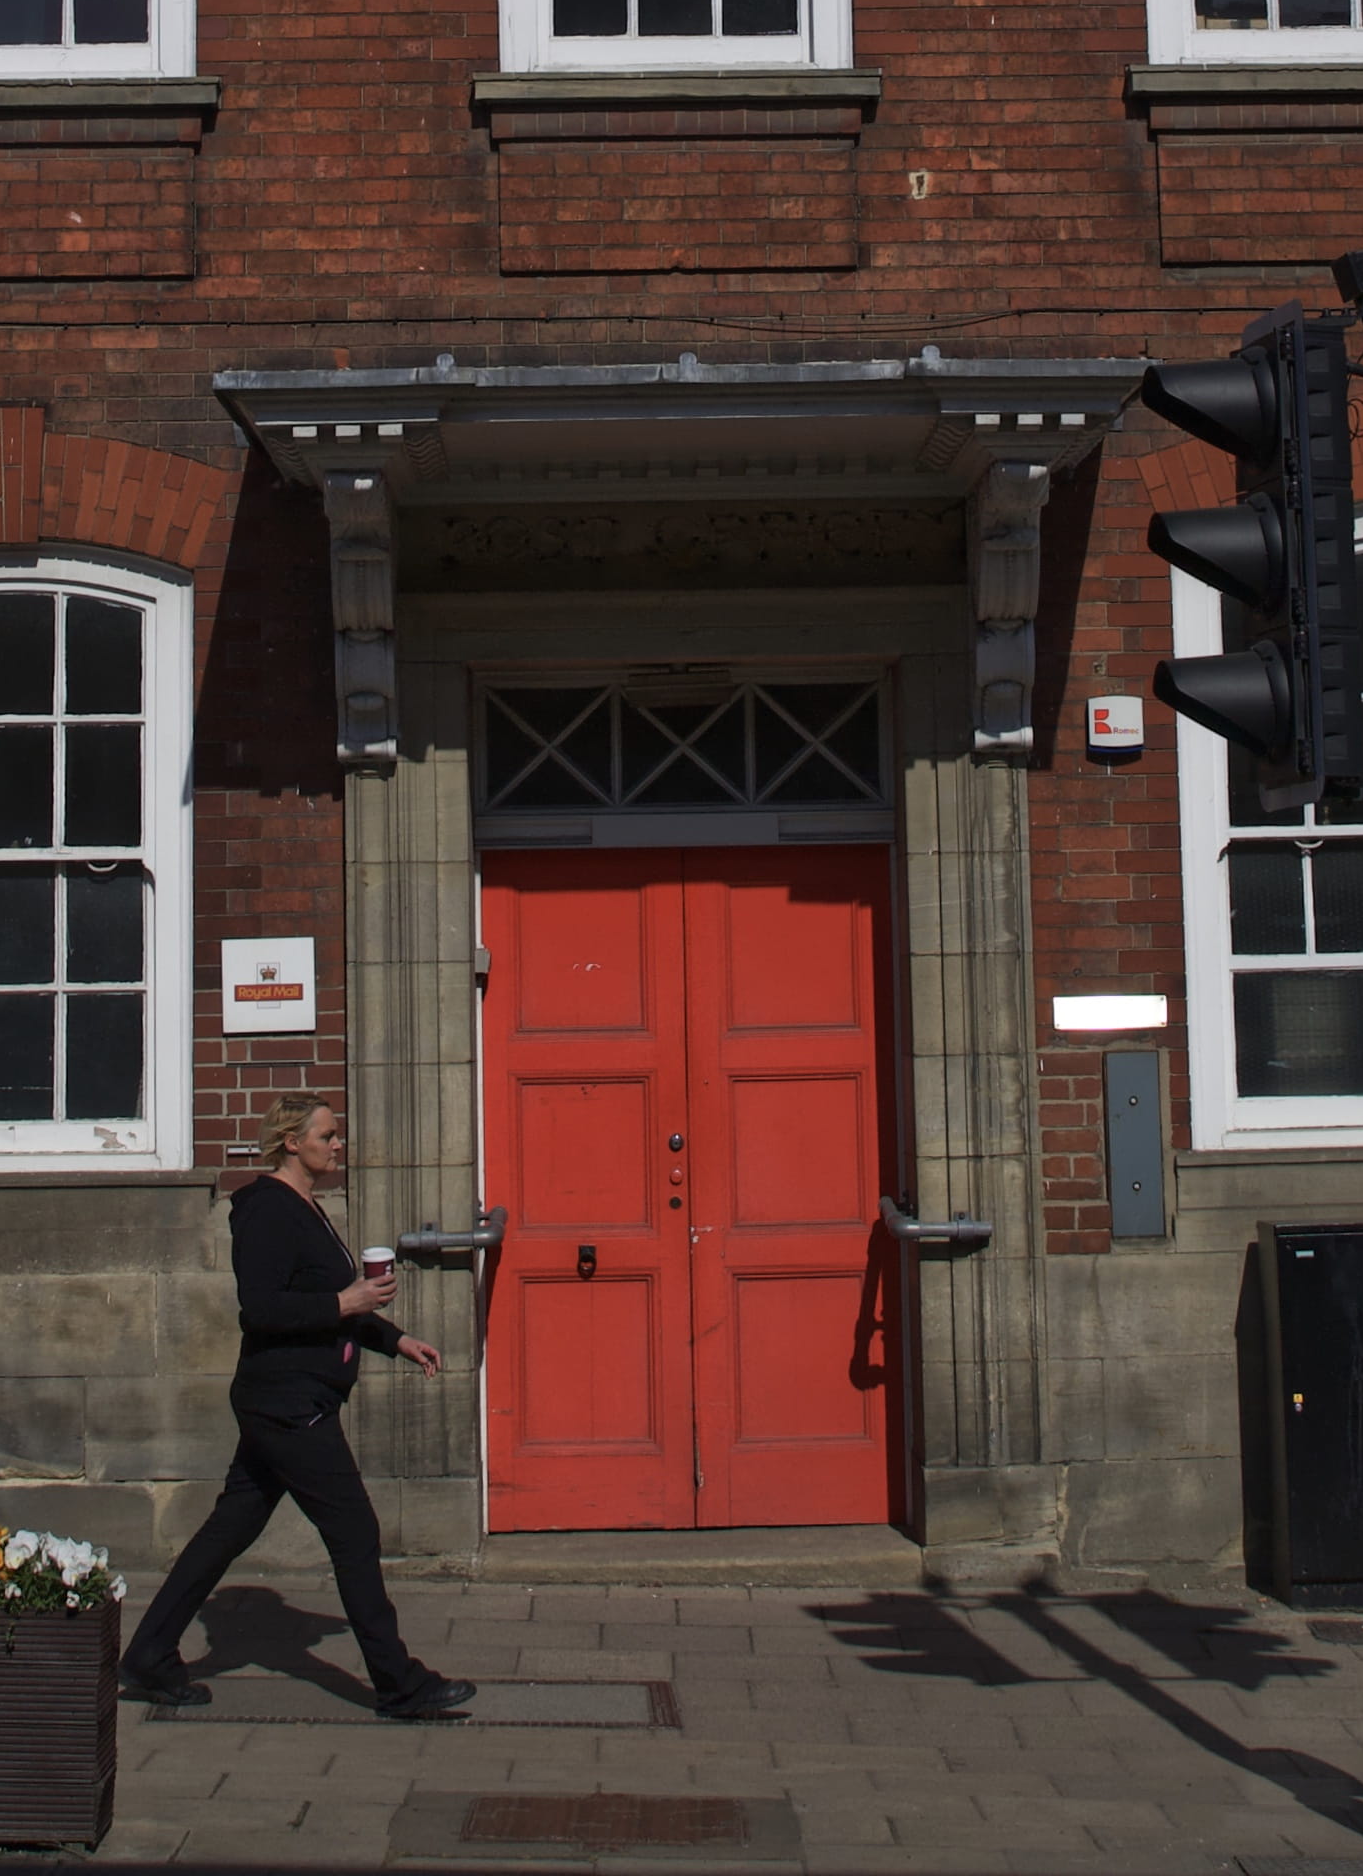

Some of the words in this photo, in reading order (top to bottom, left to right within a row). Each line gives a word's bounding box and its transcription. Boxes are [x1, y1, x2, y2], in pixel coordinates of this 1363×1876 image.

[1113, 726, 1140, 734] Romec
[239, 986, 272, 1000] Royal
[273, 985, 300, 997] Mail
